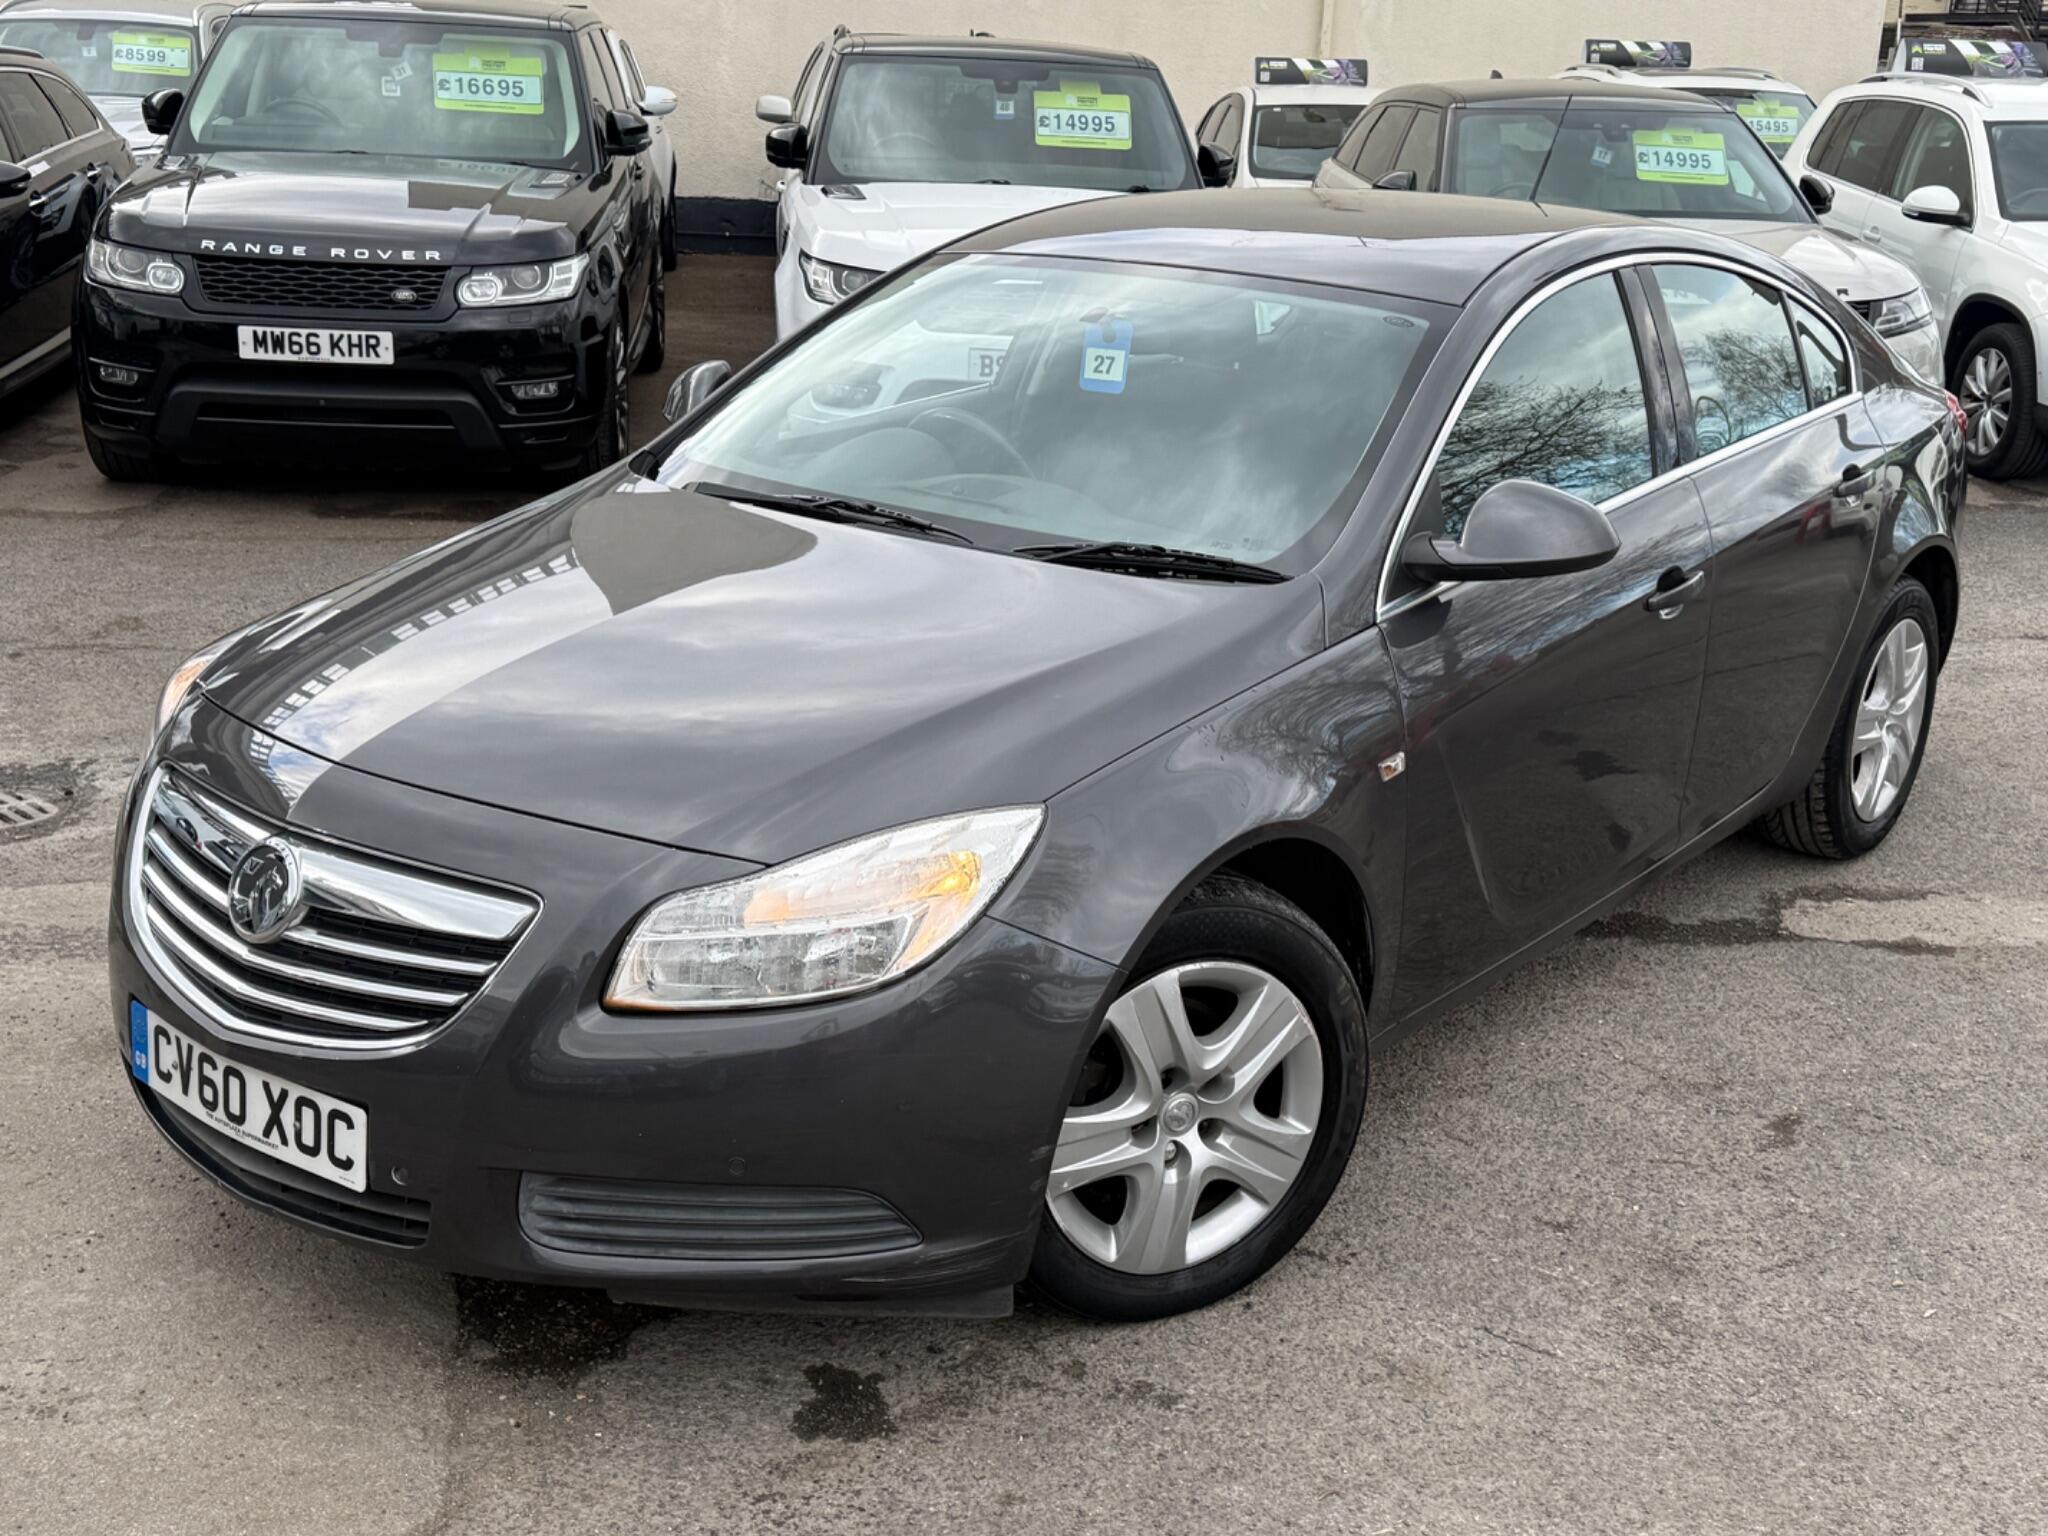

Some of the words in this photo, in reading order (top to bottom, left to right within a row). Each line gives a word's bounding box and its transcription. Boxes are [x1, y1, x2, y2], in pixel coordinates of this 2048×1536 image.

[115, 48, 166, 63] £8599
[438, 77, 525, 98] £16695
[1038, 113, 1116, 133] £14995
[1638, 151, 1712, 170] £14995
[200, 239, 307, 256] RANGE
[330, 247, 441, 261] ROVER
[252, 329, 321, 356] MW66
[329, 333, 381, 358] KHR
[1093, 355, 1116, 375] 27
[154, 1024, 247, 1127] CV60
[262, 1079, 355, 1172] XOC
